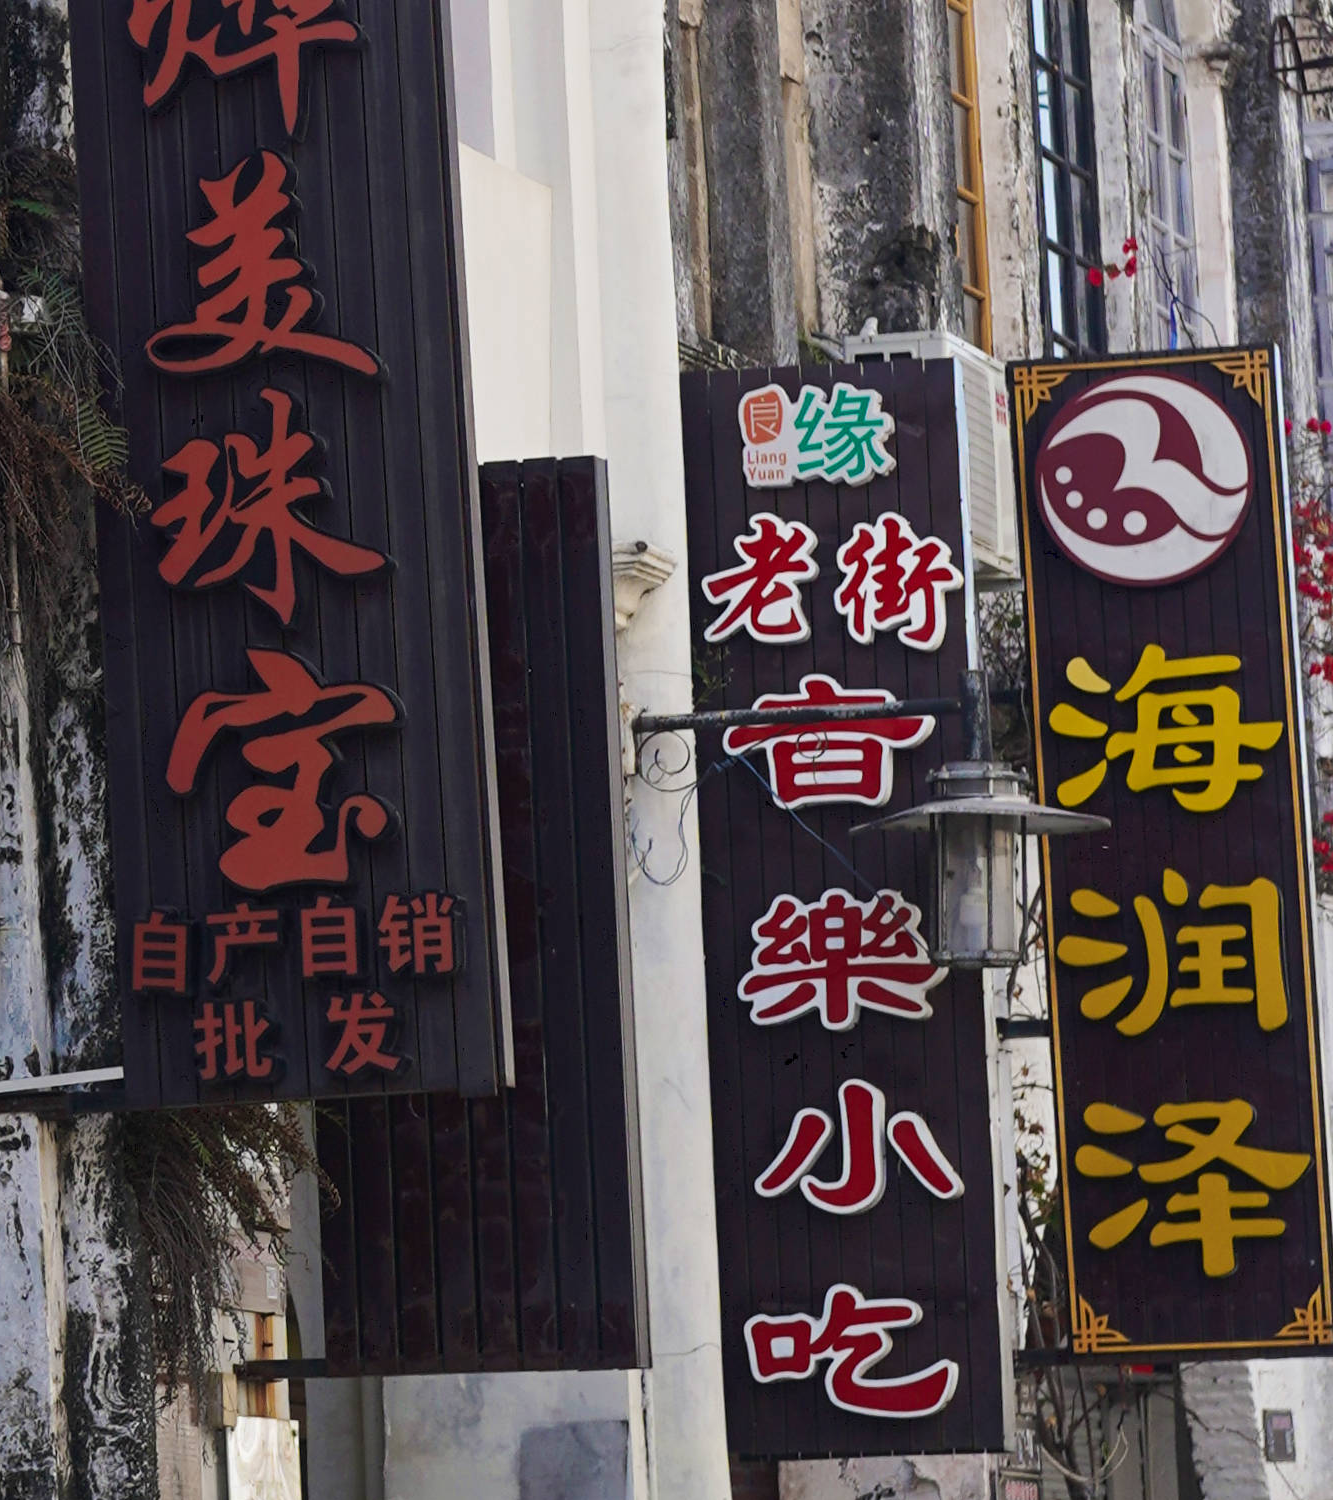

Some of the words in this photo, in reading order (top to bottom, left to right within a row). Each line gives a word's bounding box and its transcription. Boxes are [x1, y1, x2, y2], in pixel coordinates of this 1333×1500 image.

[747, 450, 787, 466] Liang
[748, 468, 785, 480] Yuan
[705, 515, 957, 646] 老街
[132, 891, 455, 994] 自产自销
[1047, 642, 1311, 1278] 海润泽
[194, 994, 399, 1079] 批发
